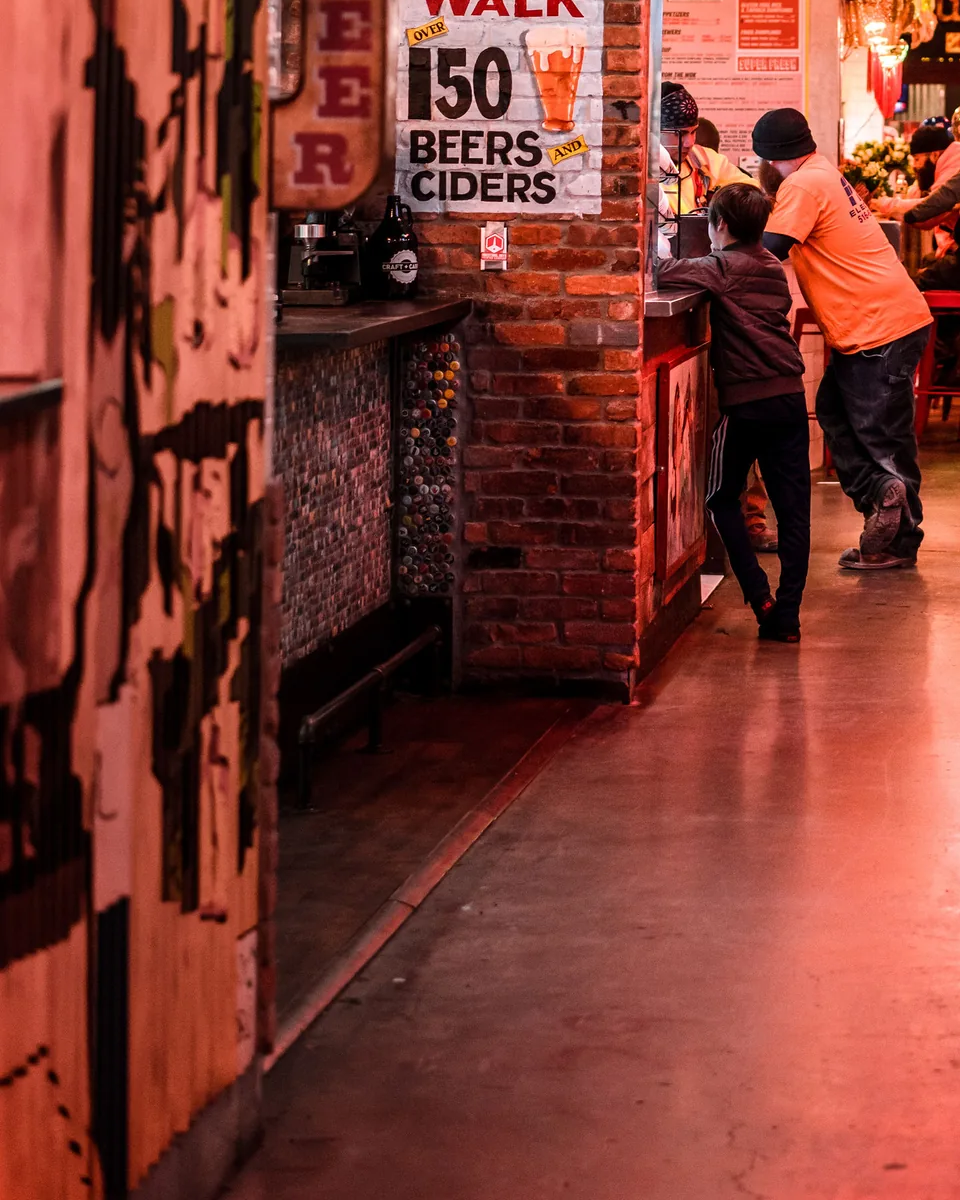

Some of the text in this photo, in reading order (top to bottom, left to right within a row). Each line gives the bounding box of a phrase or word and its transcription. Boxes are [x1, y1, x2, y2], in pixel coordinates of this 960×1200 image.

[412, 21, 447, 43] OVER
[407, 46, 513, 121] 150
[409, 130, 543, 167] BEERS
[552, 139, 584, 162] AND
[409, 171, 557, 204] CIDERS
